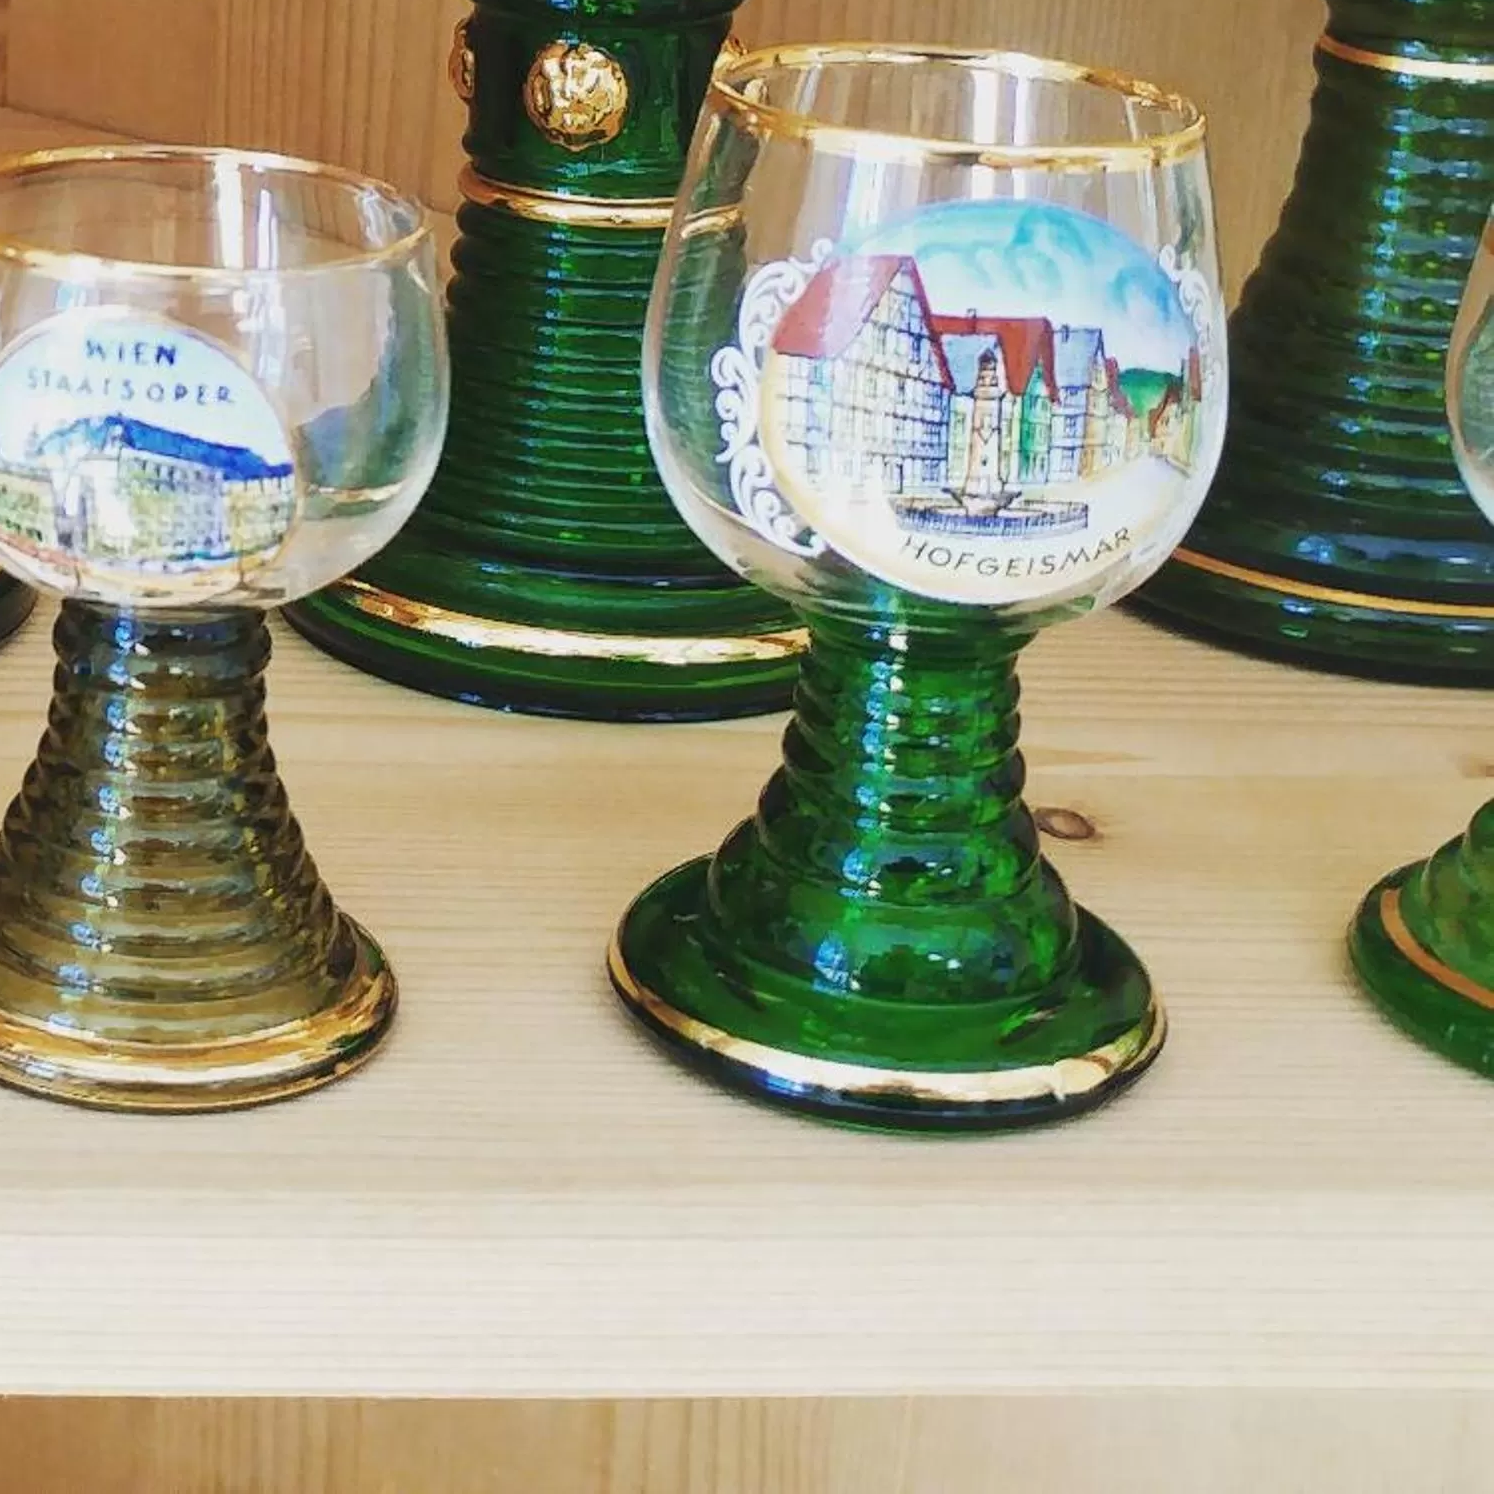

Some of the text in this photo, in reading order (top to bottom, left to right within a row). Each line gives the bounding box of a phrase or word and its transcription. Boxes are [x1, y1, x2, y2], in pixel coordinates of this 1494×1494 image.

[84, 339, 179, 367] WIEN
[25, 366, 237, 405] STAATSOPER
[899, 525, 1132, 579] HOFGEISMAR
